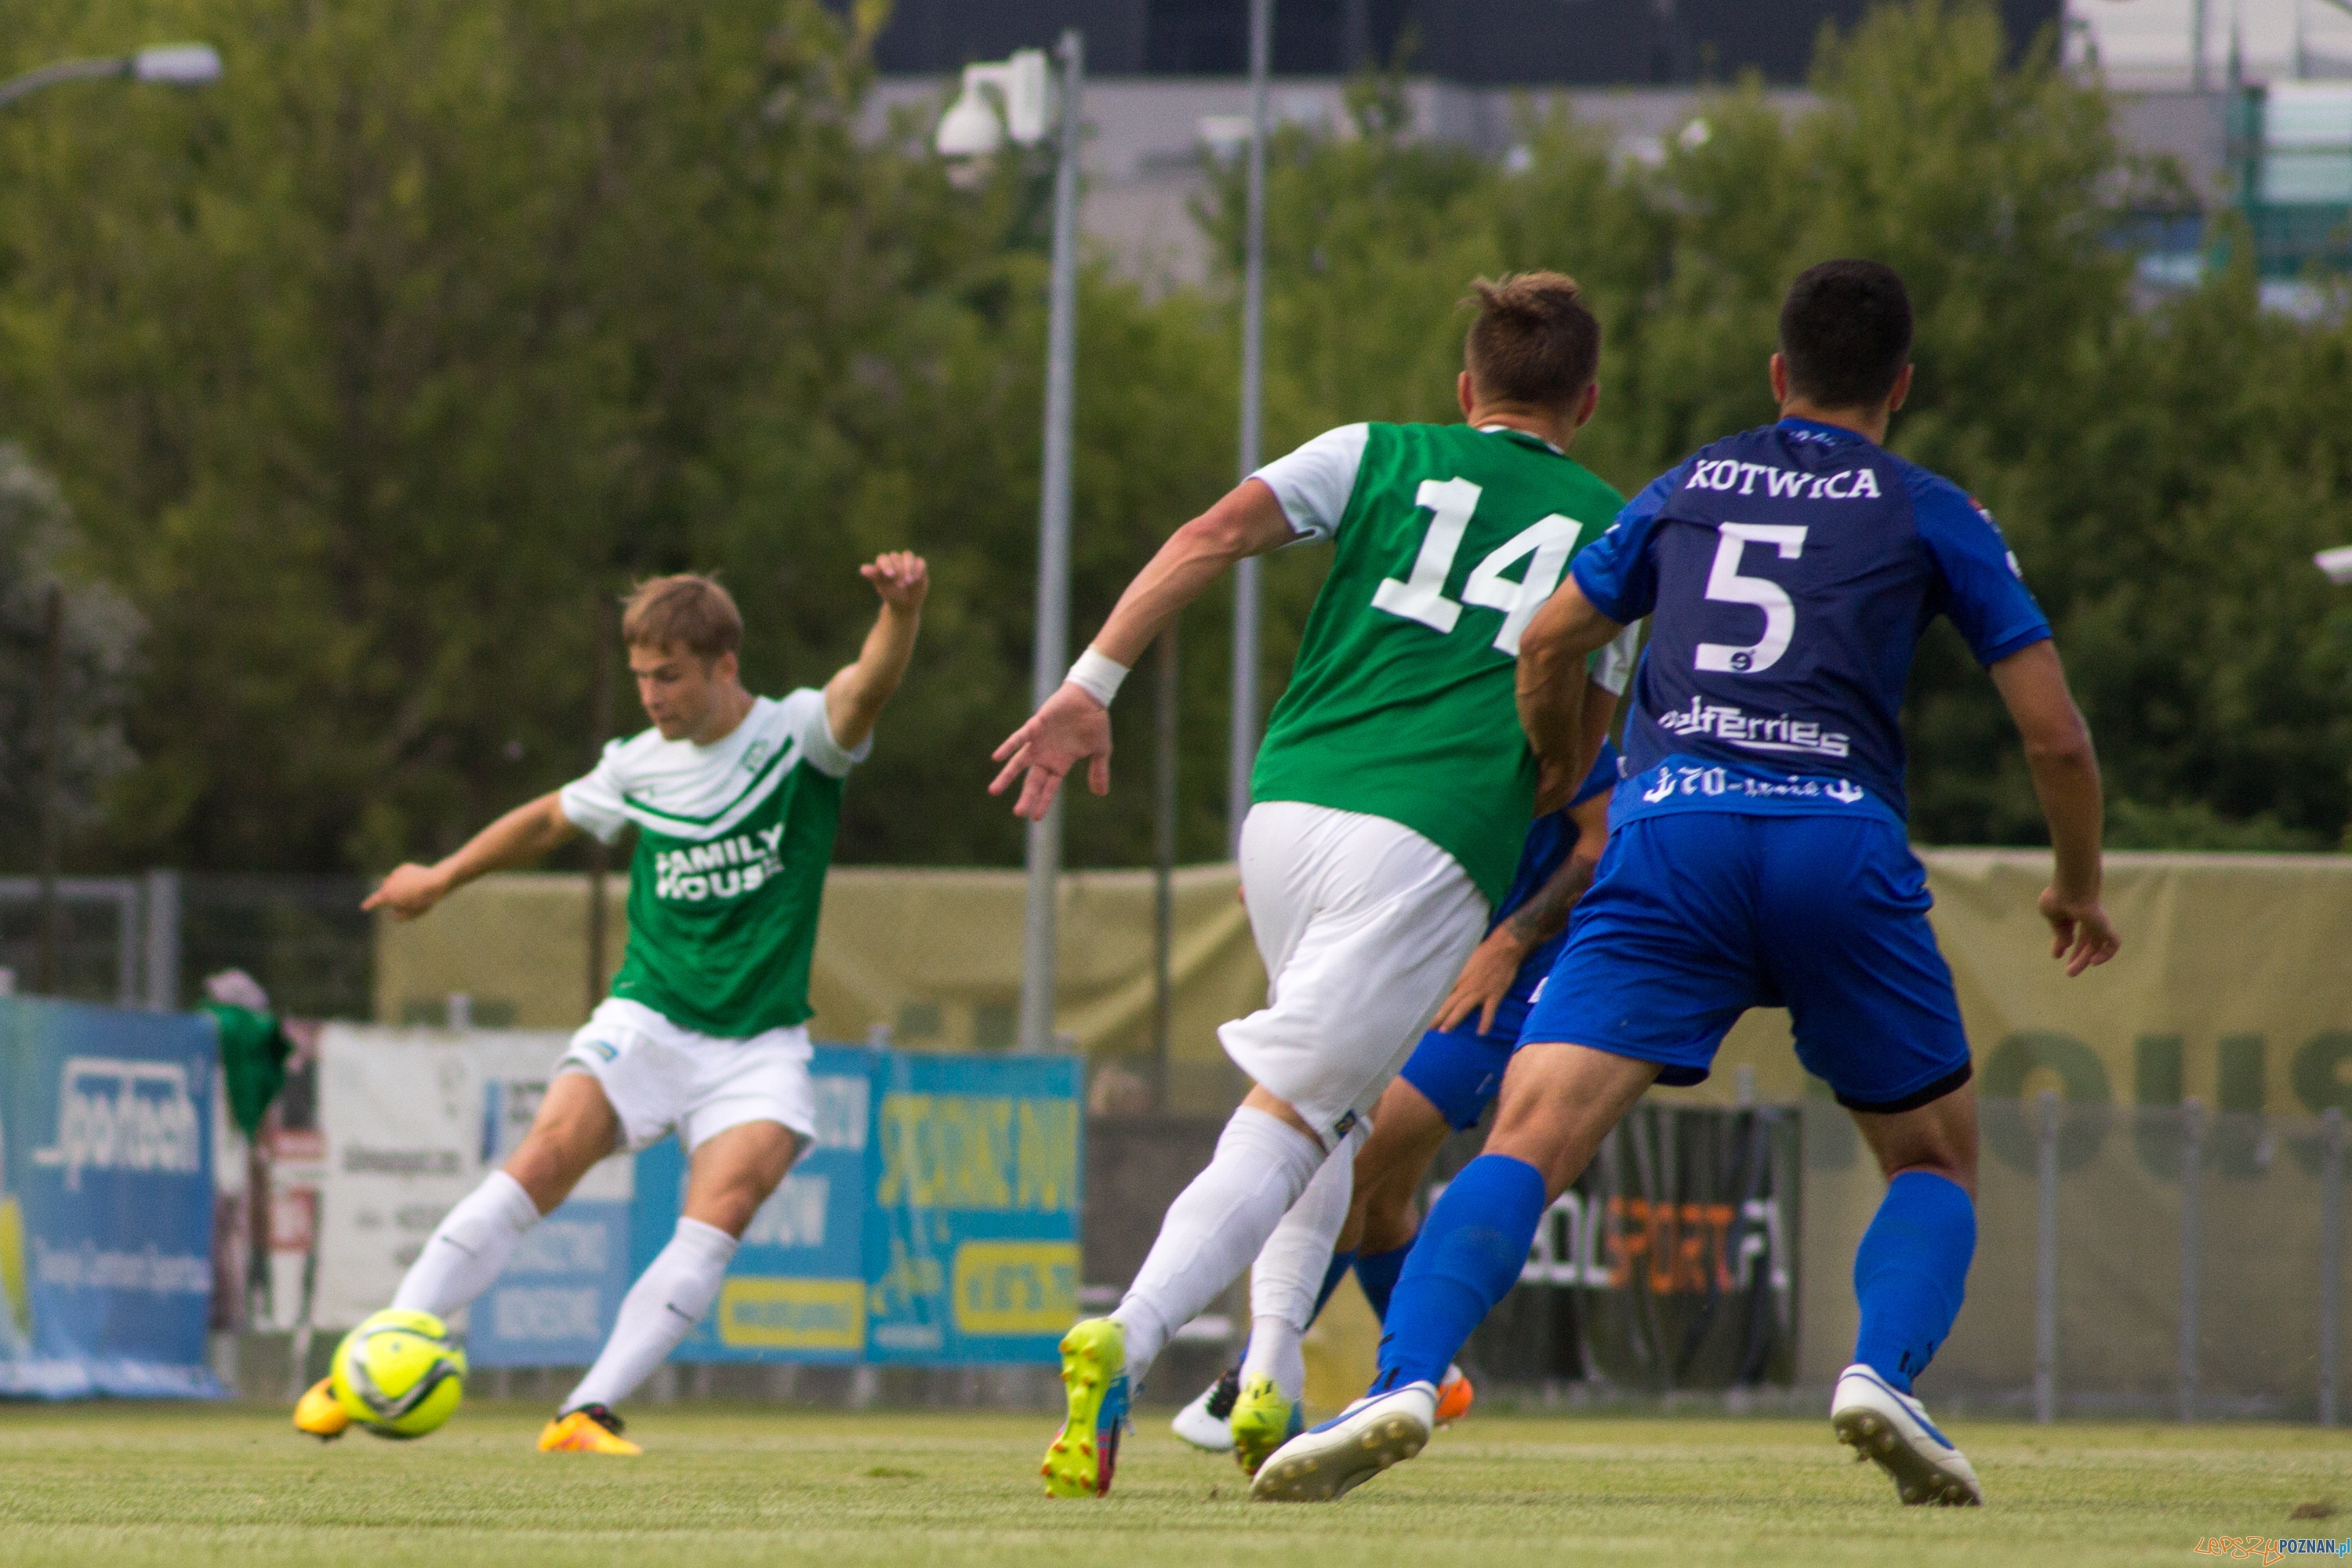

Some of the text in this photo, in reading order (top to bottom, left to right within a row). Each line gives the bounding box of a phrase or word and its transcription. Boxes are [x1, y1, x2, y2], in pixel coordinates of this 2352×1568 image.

[1686, 459, 1882, 500] KOTWICA
[1370, 475, 1584, 657] 14
[1693, 521, 1809, 674] 5
[655, 822, 784, 874] FAMILY
